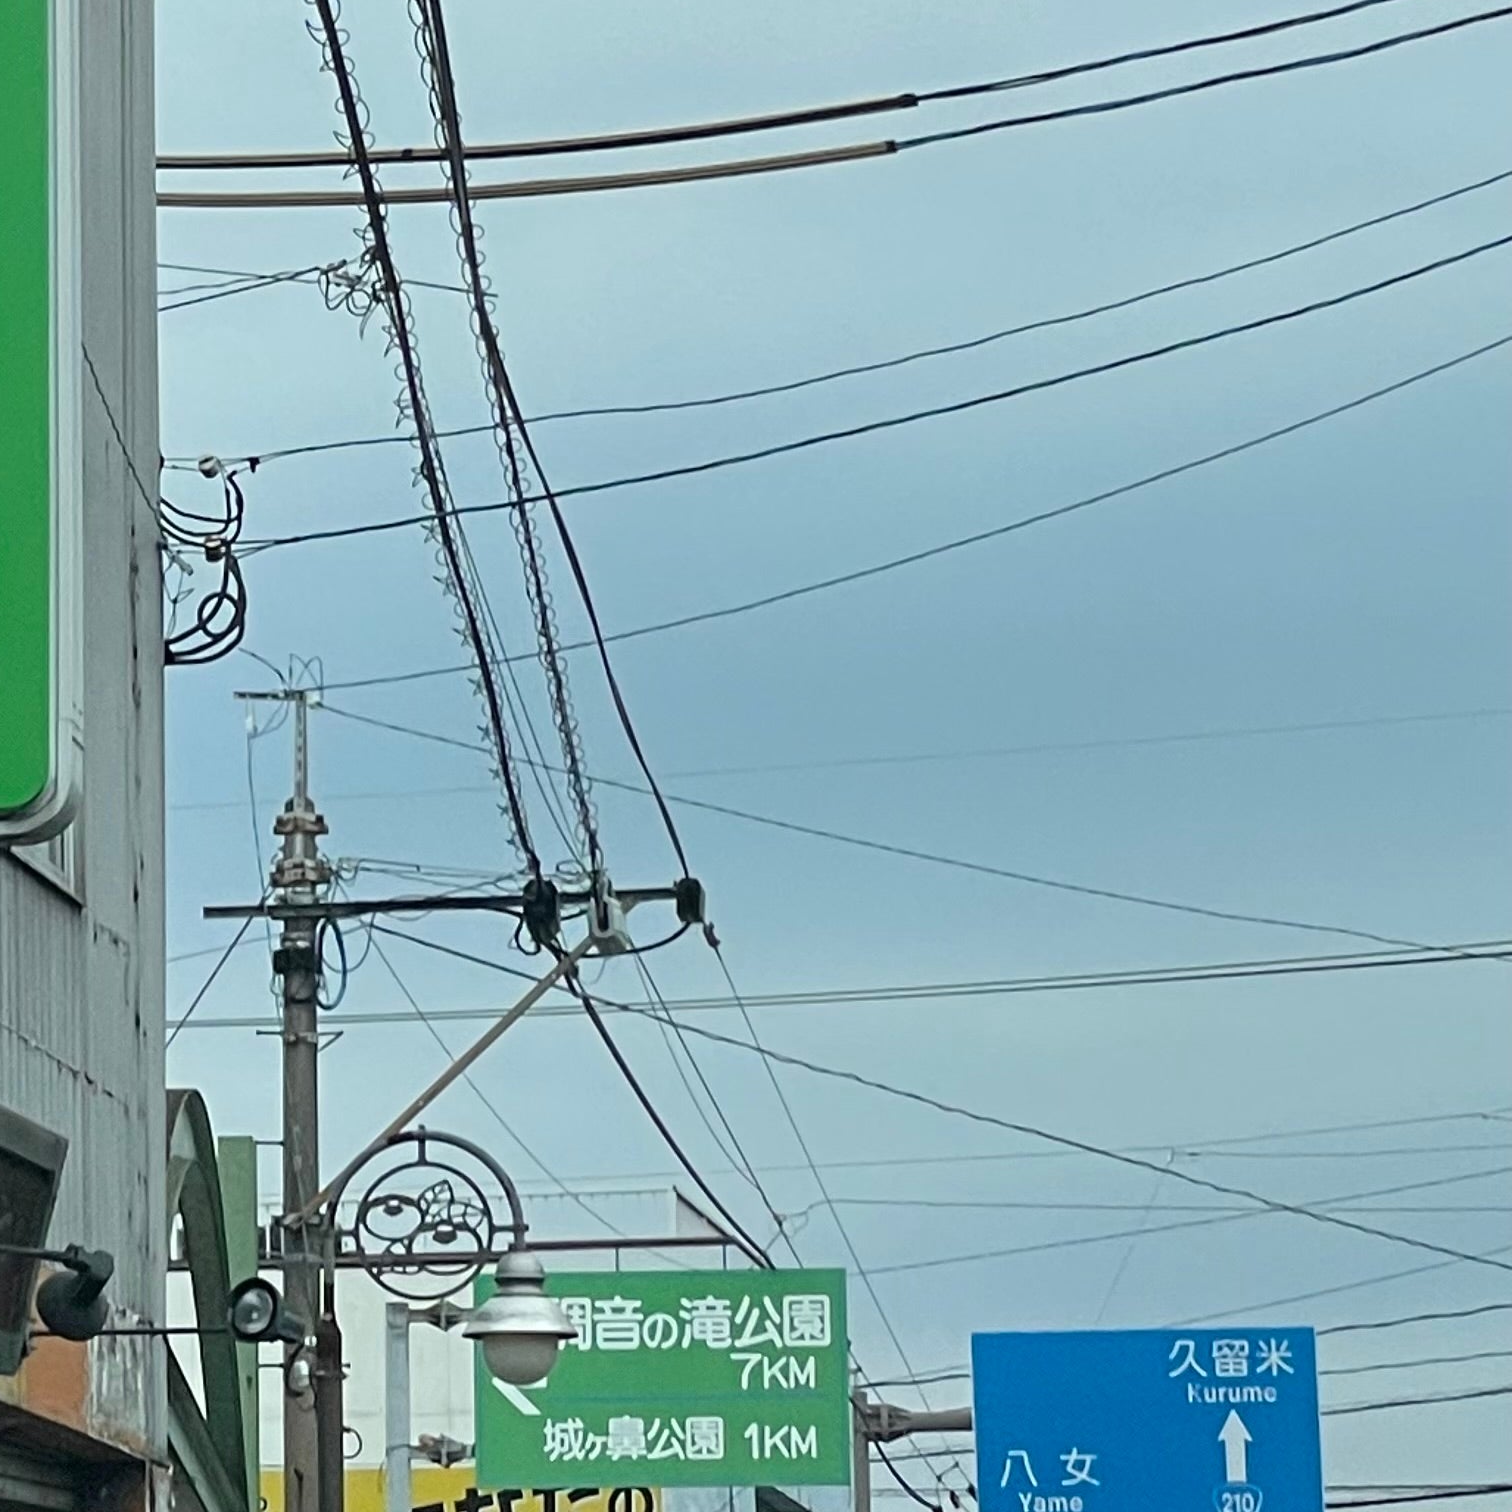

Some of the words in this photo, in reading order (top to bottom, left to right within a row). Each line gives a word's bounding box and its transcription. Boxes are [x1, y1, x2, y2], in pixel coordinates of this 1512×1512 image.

[730, 1352, 816, 1390] 7KM
[1168, 1337, 1295, 1378] 久留米
[1188, 1382, 1278, 1404] Kurume
[743, 1421, 819, 1460] 1KM
[1018, 1491, 1084, 1512] Yame
[1221, 1492, 1255, 1512] 210
